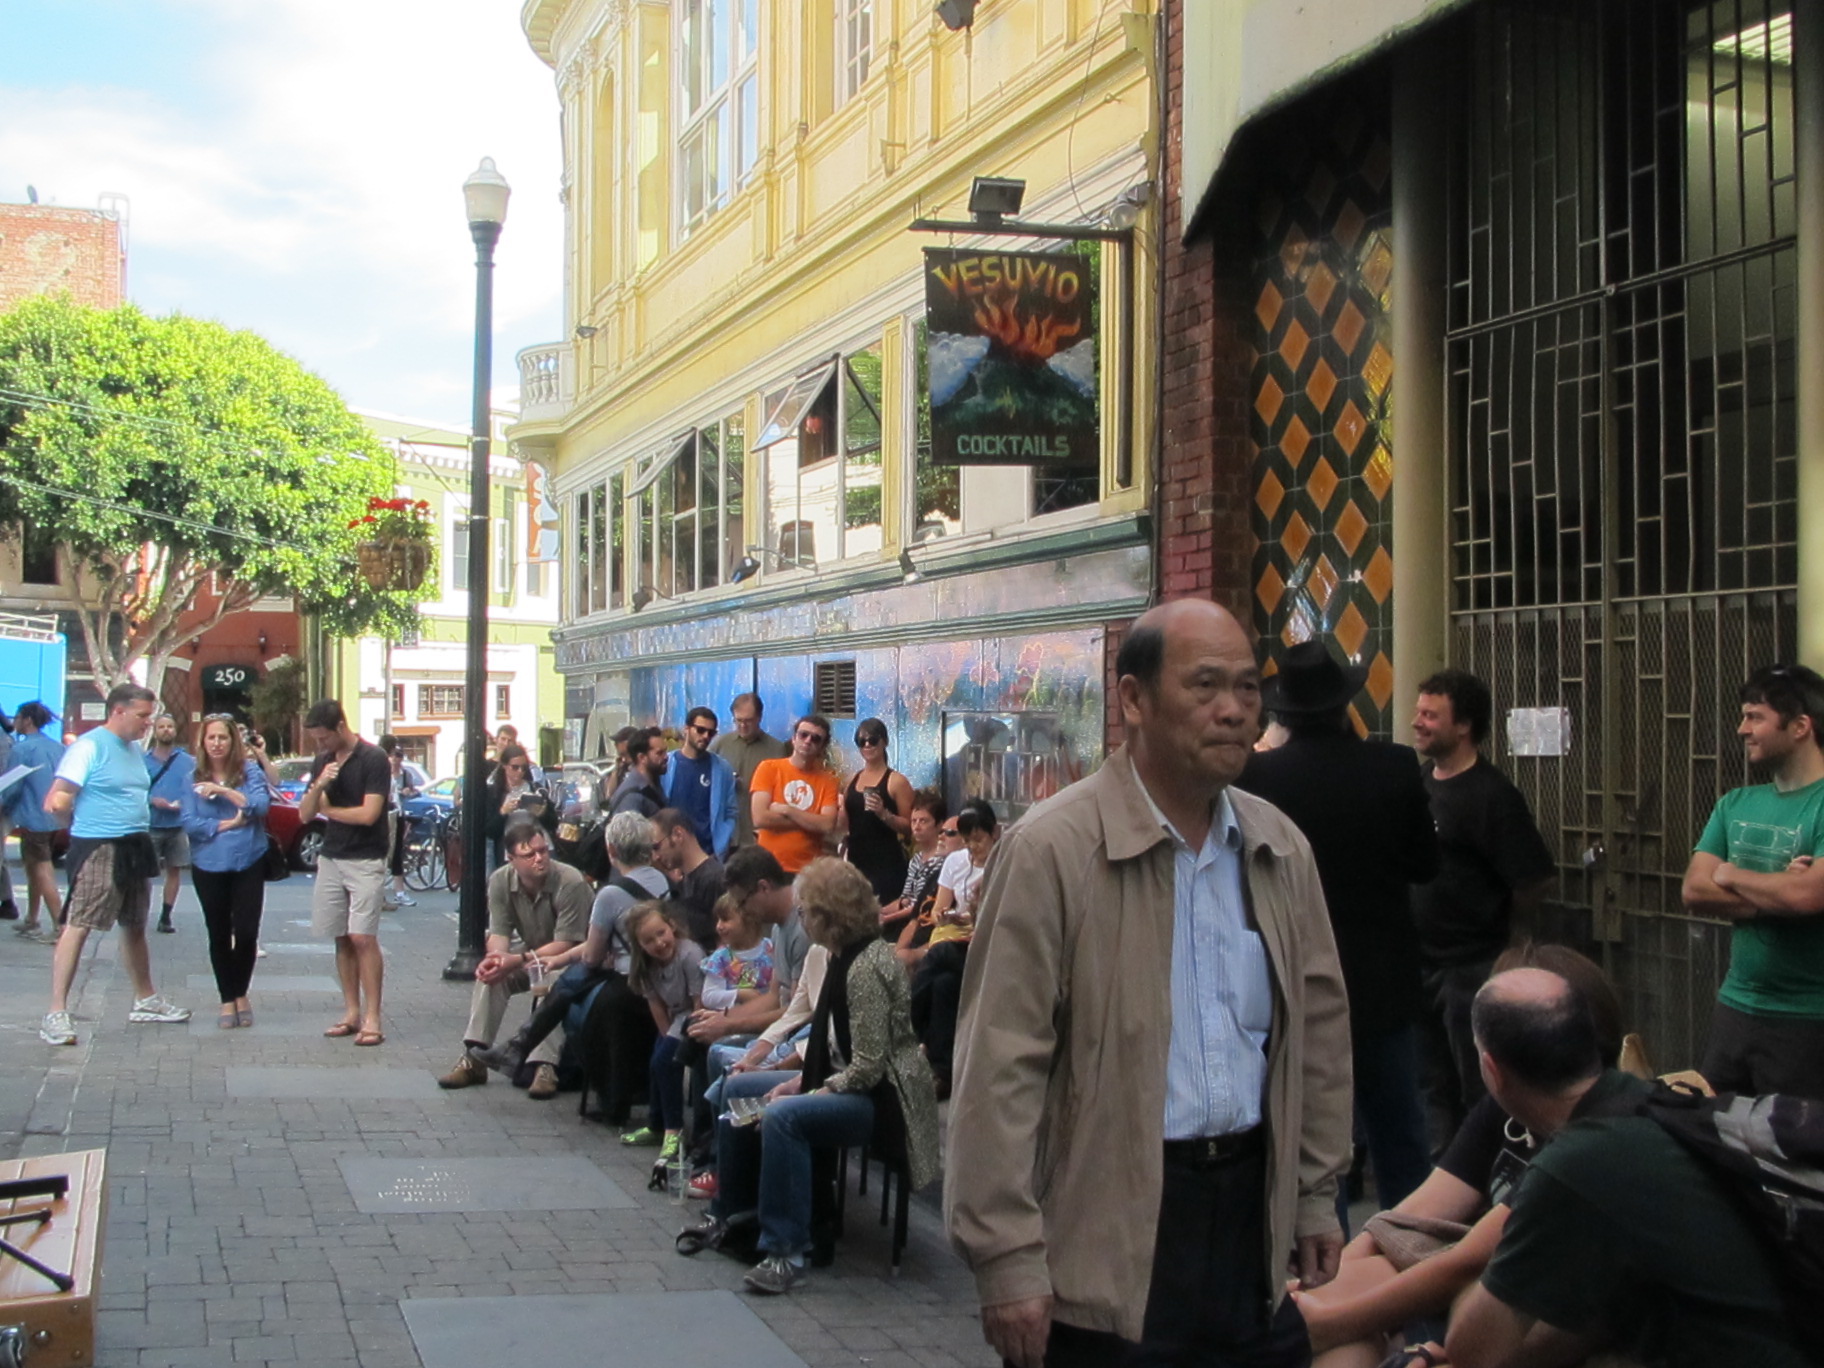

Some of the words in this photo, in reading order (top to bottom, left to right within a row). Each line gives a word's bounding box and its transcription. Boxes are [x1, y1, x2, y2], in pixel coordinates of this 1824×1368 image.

[931, 256, 1080, 303] VESUVIO
[956, 434, 1070, 458] COCKTAILS
[215, 668, 246, 686] 250
